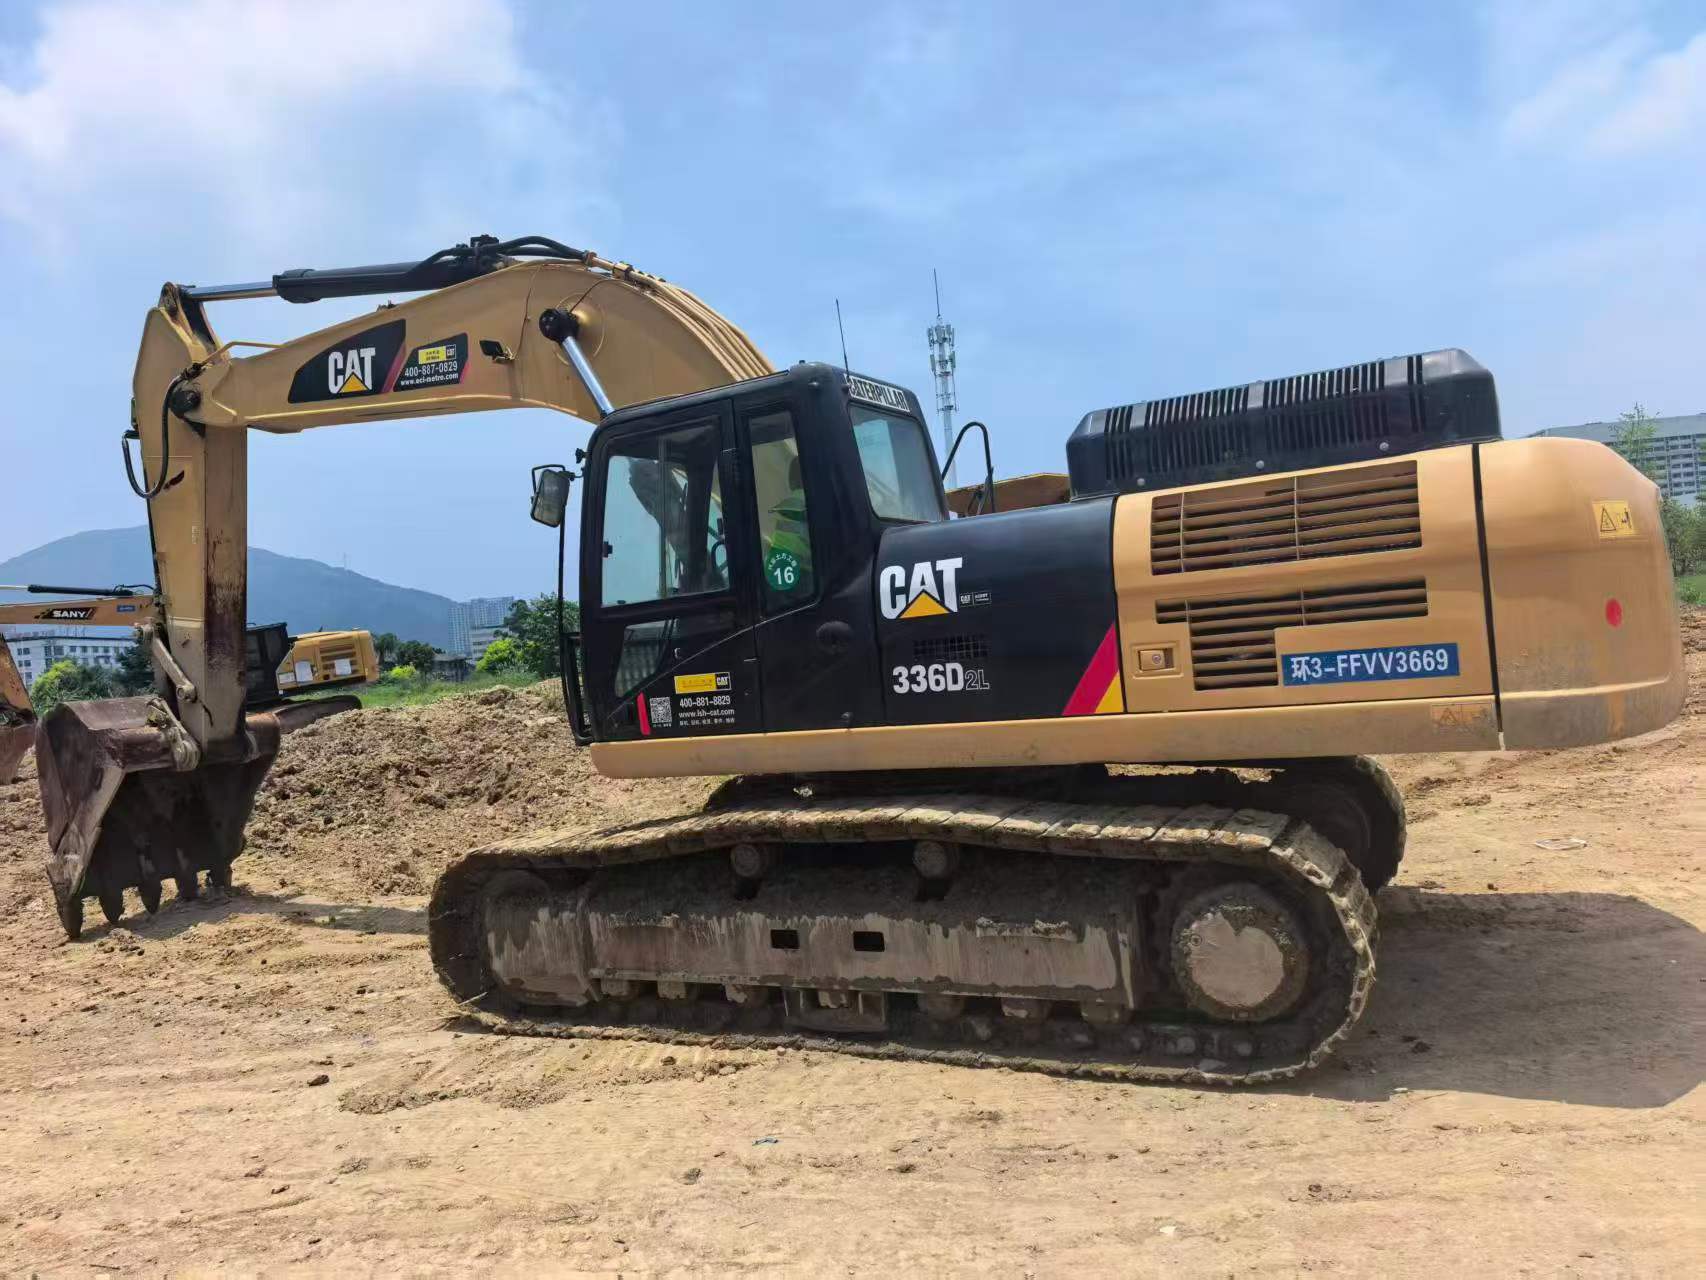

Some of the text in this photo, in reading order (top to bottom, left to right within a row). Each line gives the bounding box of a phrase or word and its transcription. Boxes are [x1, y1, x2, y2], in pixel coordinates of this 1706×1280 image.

[328, 347, 376, 394] CAT
[404, 361, 458, 377] 400-887-0829
[774, 566, 795, 584] 16
[880, 557, 963, 620] CAT
[1290, 649, 1448, 681] 环3-FFVV3669
[716, 676, 728, 686] CAT
[679, 695, 731, 708] 400-881-8829
